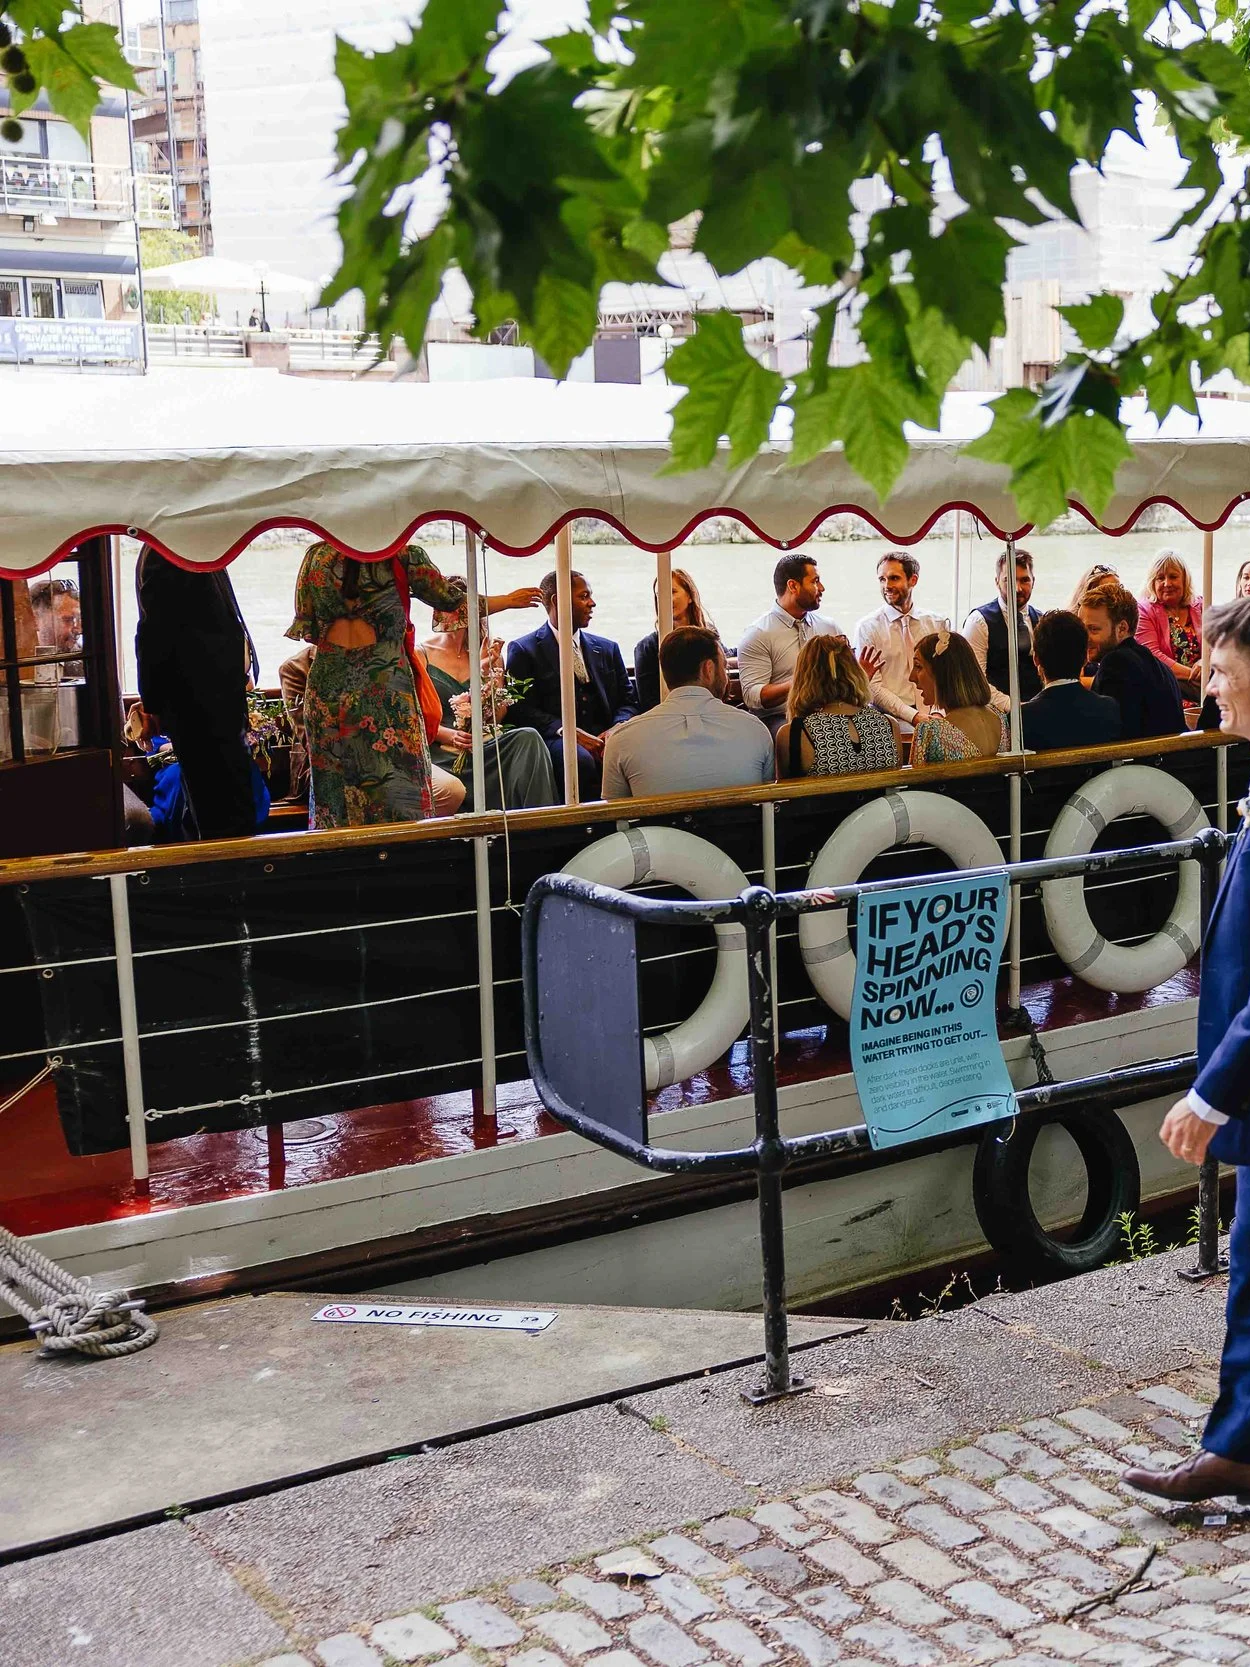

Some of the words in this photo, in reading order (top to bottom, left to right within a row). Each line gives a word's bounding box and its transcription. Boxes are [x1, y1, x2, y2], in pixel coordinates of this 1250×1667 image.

[868, 902, 900, 940] IF
[903, 886, 999, 935] YOUR
[866, 913, 996, 978] HEAD'S
[862, 947, 992, 1003] SPINNING
[860, 988, 955, 1031] NOW...
[861, 1034, 902, 1052] IMAGINE
[902, 1029, 930, 1043] BEING
[931, 1026, 941, 1037] IN
[942, 1022, 963, 1034] THIS
[862, 1049, 895, 1064] WATER
[895, 1041, 930, 1057] TRYING
[930, 1038, 943, 1049] TO
[944, 1034, 962, 1045] GET
[366, 1309, 402, 1318] NO
[408, 1311, 503, 1322] FISHING
